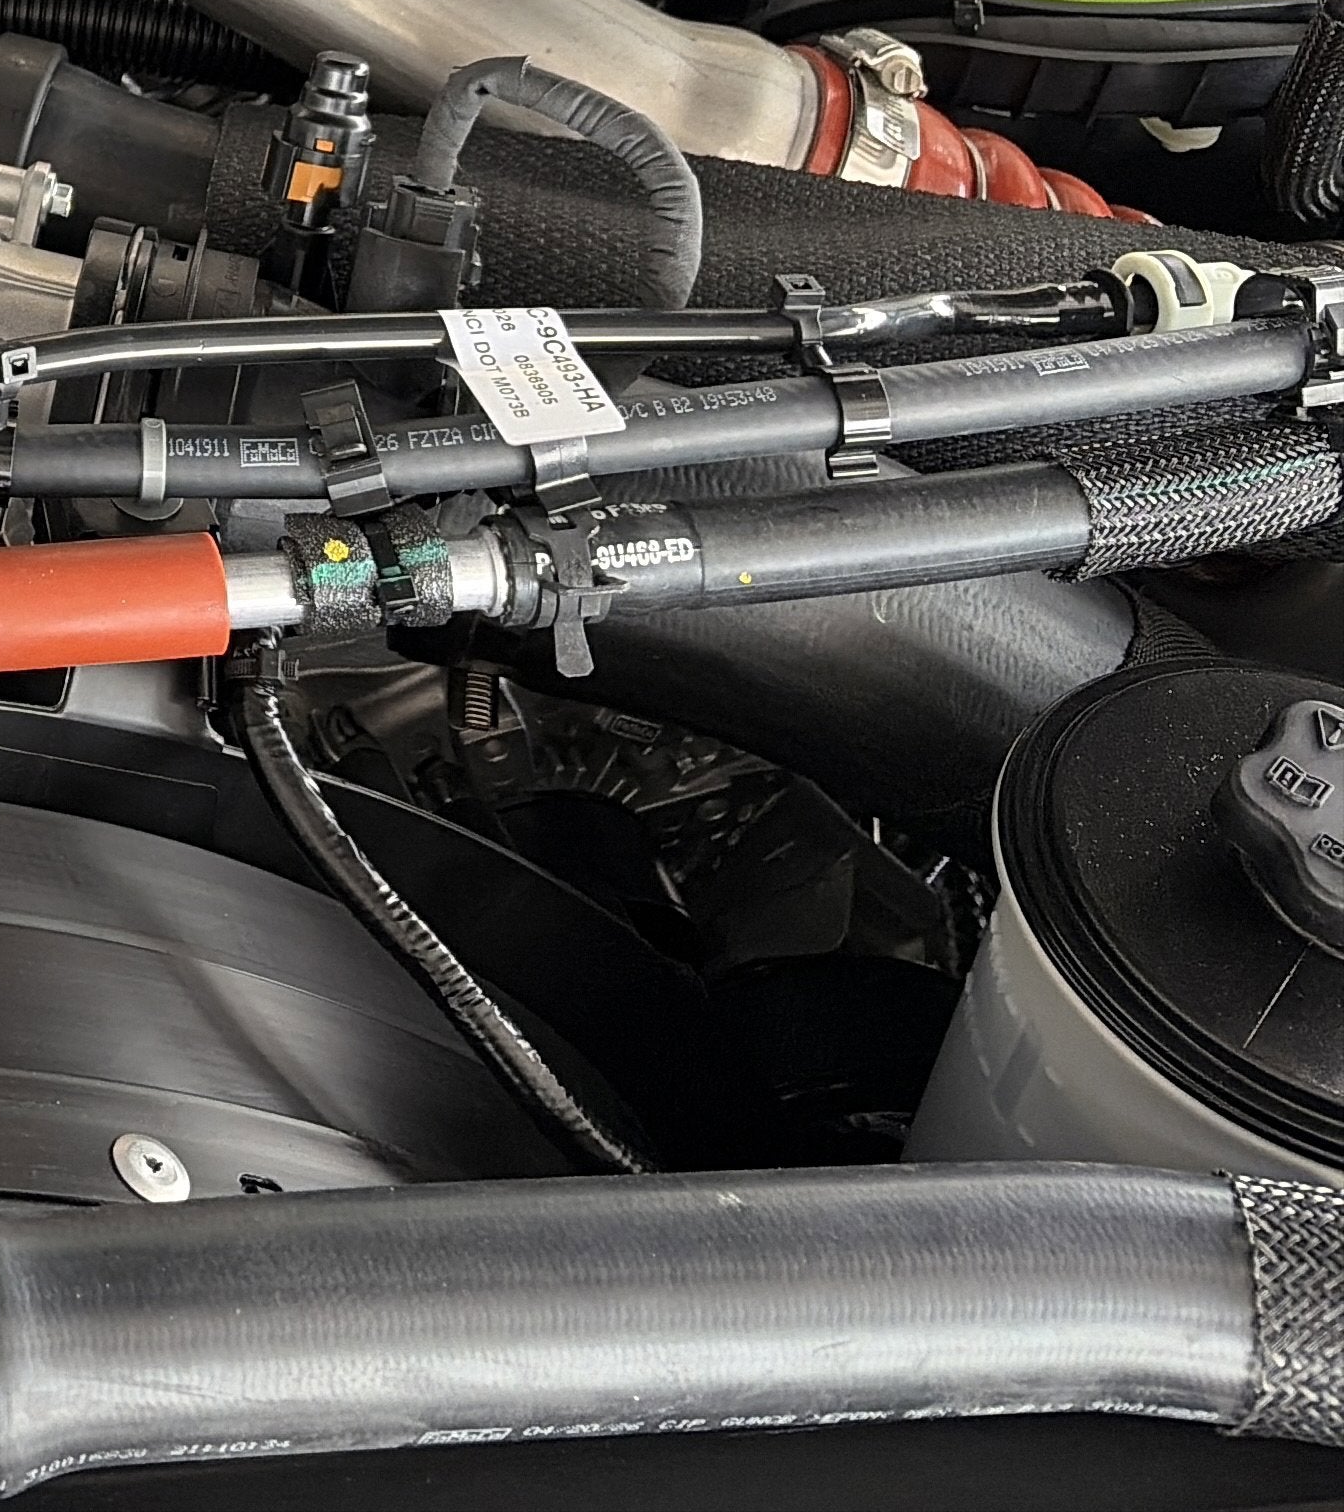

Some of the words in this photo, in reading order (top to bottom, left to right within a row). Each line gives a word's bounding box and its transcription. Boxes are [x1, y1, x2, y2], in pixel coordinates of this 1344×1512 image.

[473, 341, 502, 374] DOT
[168, 438, 230, 458] 1041911
[671, 396, 695, 415] B2
[702, 386, 778, 411] 19:53:48
